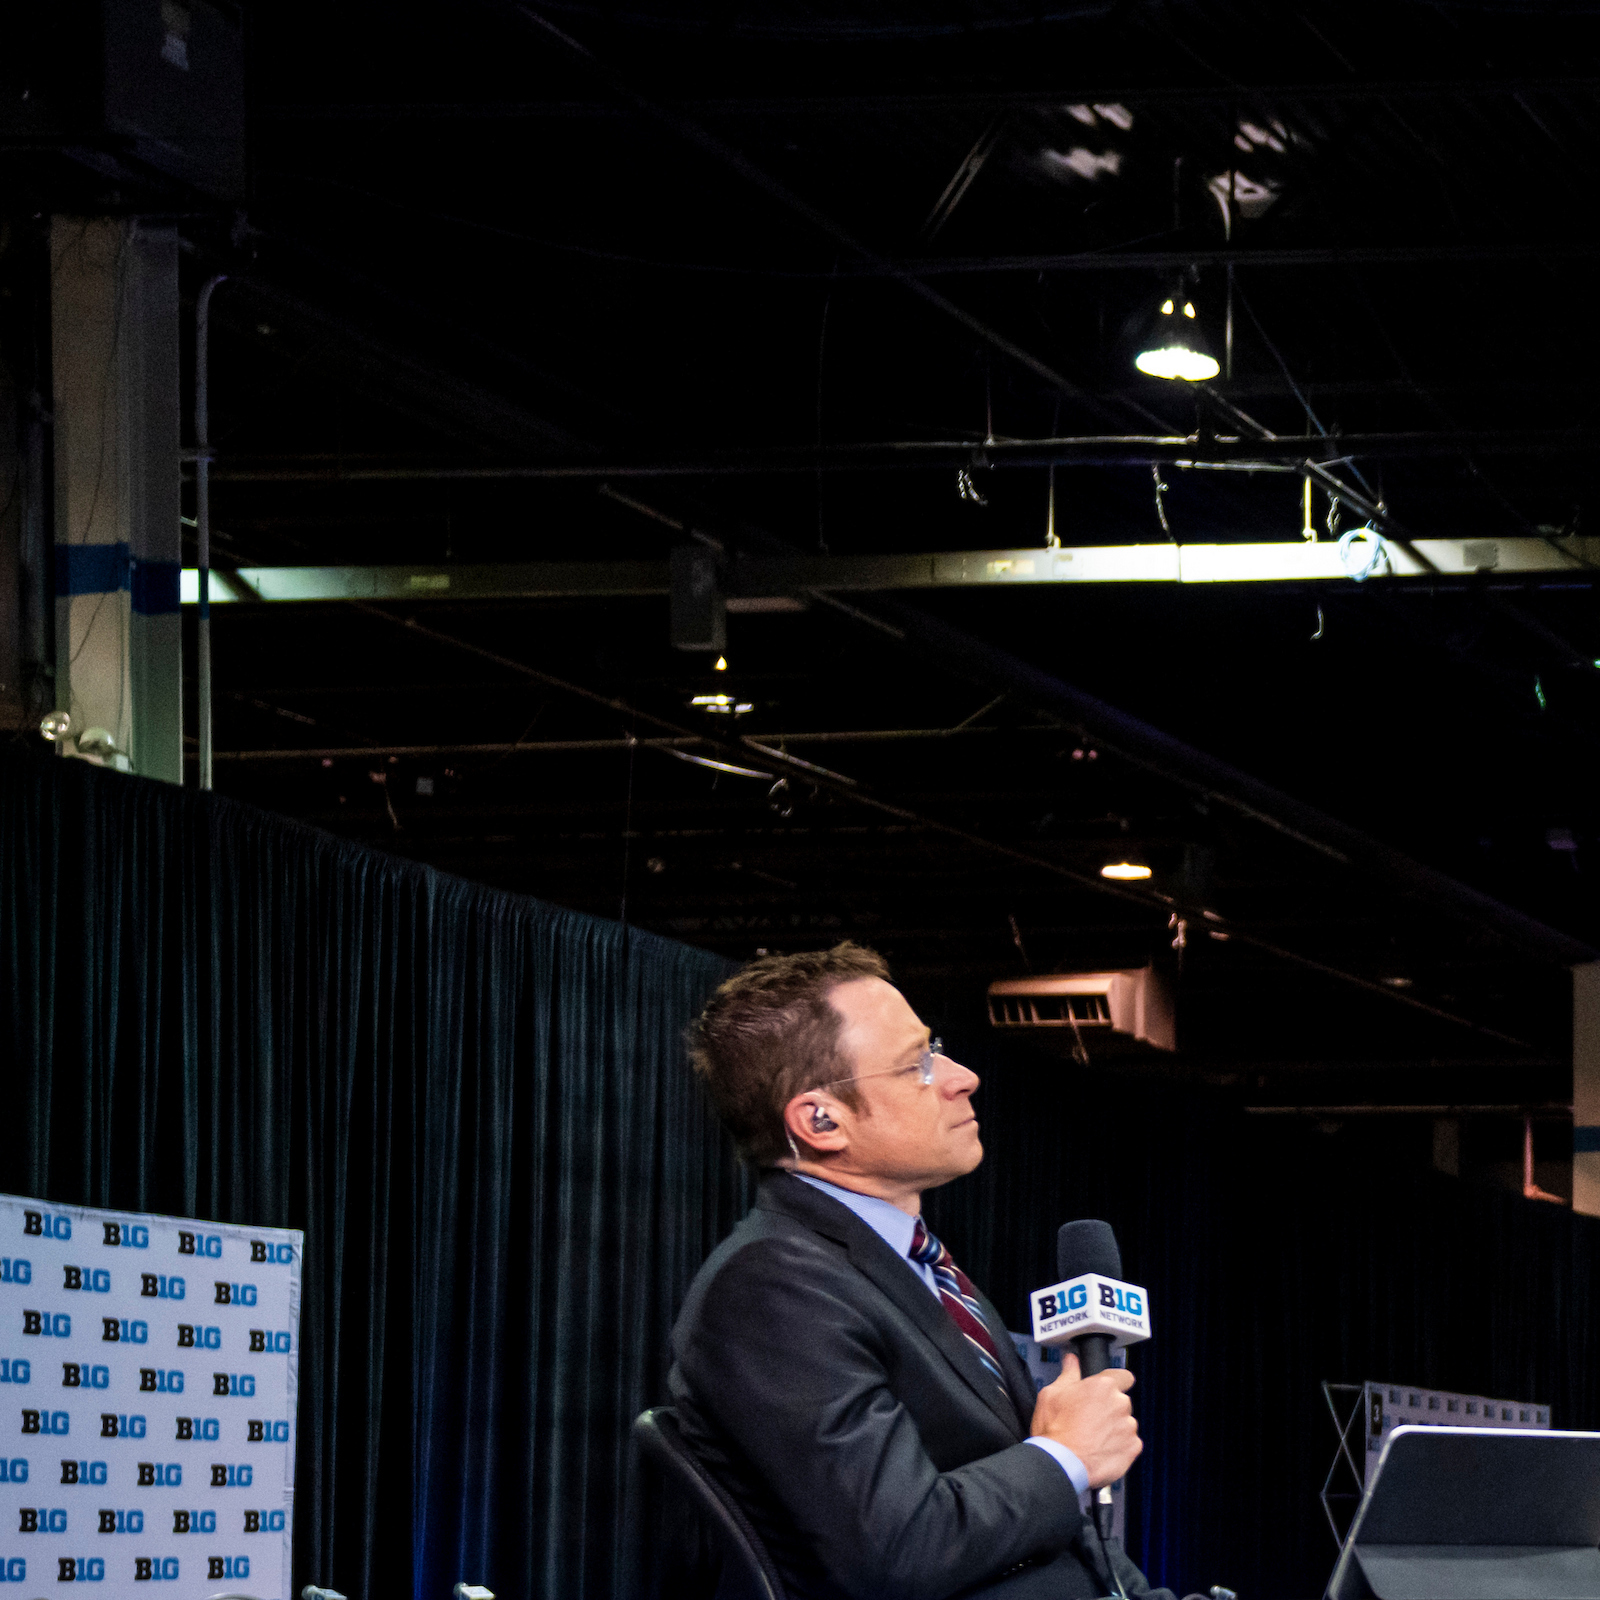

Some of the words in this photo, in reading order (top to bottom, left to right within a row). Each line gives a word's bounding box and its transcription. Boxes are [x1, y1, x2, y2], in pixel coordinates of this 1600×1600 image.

[24, 1209, 72, 1240] B1G
[103, 1221, 149, 1249] B1G
[178, 1230, 222, 1259] B1G
[250, 1240, 293, 1264] B1G
[0, 1256, 32, 1285] 1G
[63, 1265, 110, 1293] B1G
[141, 1273, 185, 1300] B1G
[215, 1282, 257, 1307] B1G
[1038, 1284, 1087, 1320] B1G
[1098, 1283, 1142, 1315] B1G
[23, 1309, 71, 1338] B1G
[102, 1317, 148, 1344] B1G
[177, 1324, 221, 1350] B1G
[249, 1330, 291, 1353] B1G
[1040, 1310, 1089, 1334] NETWORK
[1100, 1309, 1144, 1330] NETWORK
[0, 1358, 30, 1385] 1G
[62, 1363, 109, 1390] B1G
[140, 1368, 184, 1394] B1G
[213, 1373, 255, 1397] B1G
[21, 1409, 69, 1436] B1G
[100, 1413, 146, 1439] B1G
[176, 1417, 219, 1441] B1G
[247, 1419, 289, 1443] B1G
[0, 1458, 29, 1484] 1G
[60, 1460, 107, 1486] B1G
[137, 1463, 182, 1487] B1G
[211, 1464, 252, 1487] B1G
[19, 1508, 67, 1534] B1G
[98, 1509, 144, 1534] B1G
[173, 1510, 216, 1533] B1G
[244, 1510, 285, 1533] B1G
[58, 1557, 104, 1582] B1G
[135, 1557, 179, 1581] B1G
[208, 1556, 249, 1580] B1G
